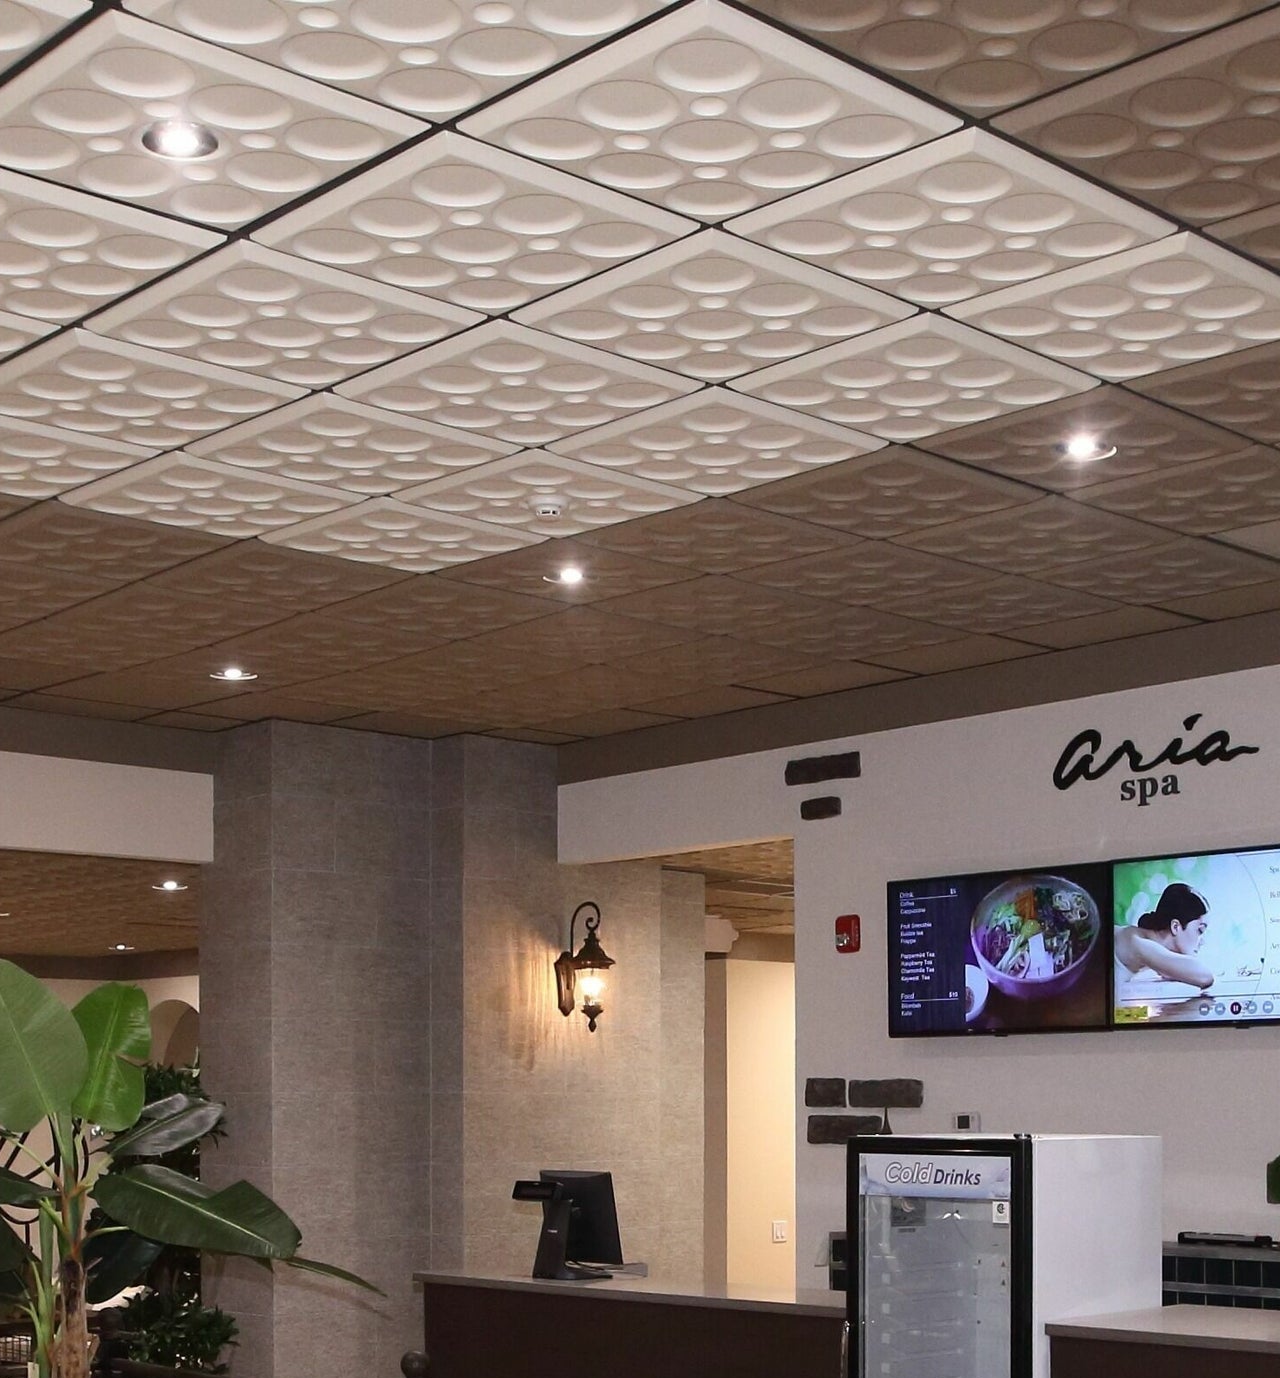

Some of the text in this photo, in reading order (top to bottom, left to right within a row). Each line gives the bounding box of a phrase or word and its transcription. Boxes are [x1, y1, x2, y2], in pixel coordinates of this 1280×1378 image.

[1120, 774, 1180, 807] spa
[885, 1161, 981, 1186] Cold Drinks
